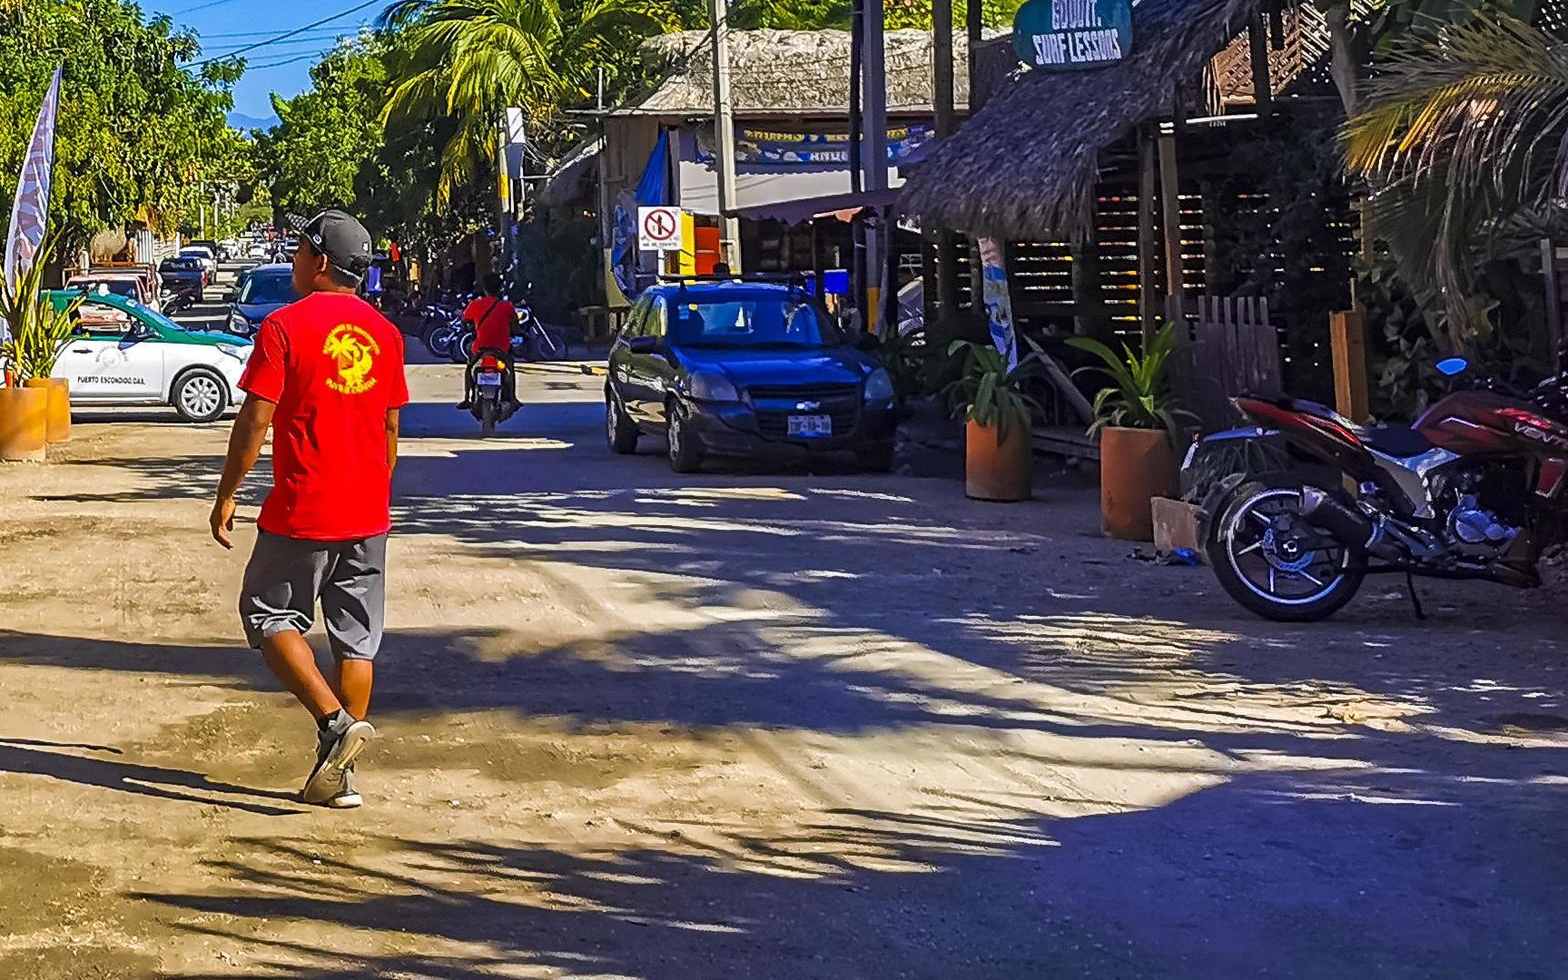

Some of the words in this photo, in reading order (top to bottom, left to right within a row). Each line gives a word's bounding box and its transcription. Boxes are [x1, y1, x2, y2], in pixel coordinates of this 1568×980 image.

[1032, 33, 1067, 65] SURF
[1067, 28, 1122, 62] LESSONS
[77, 375, 98, 384] PUERTO
